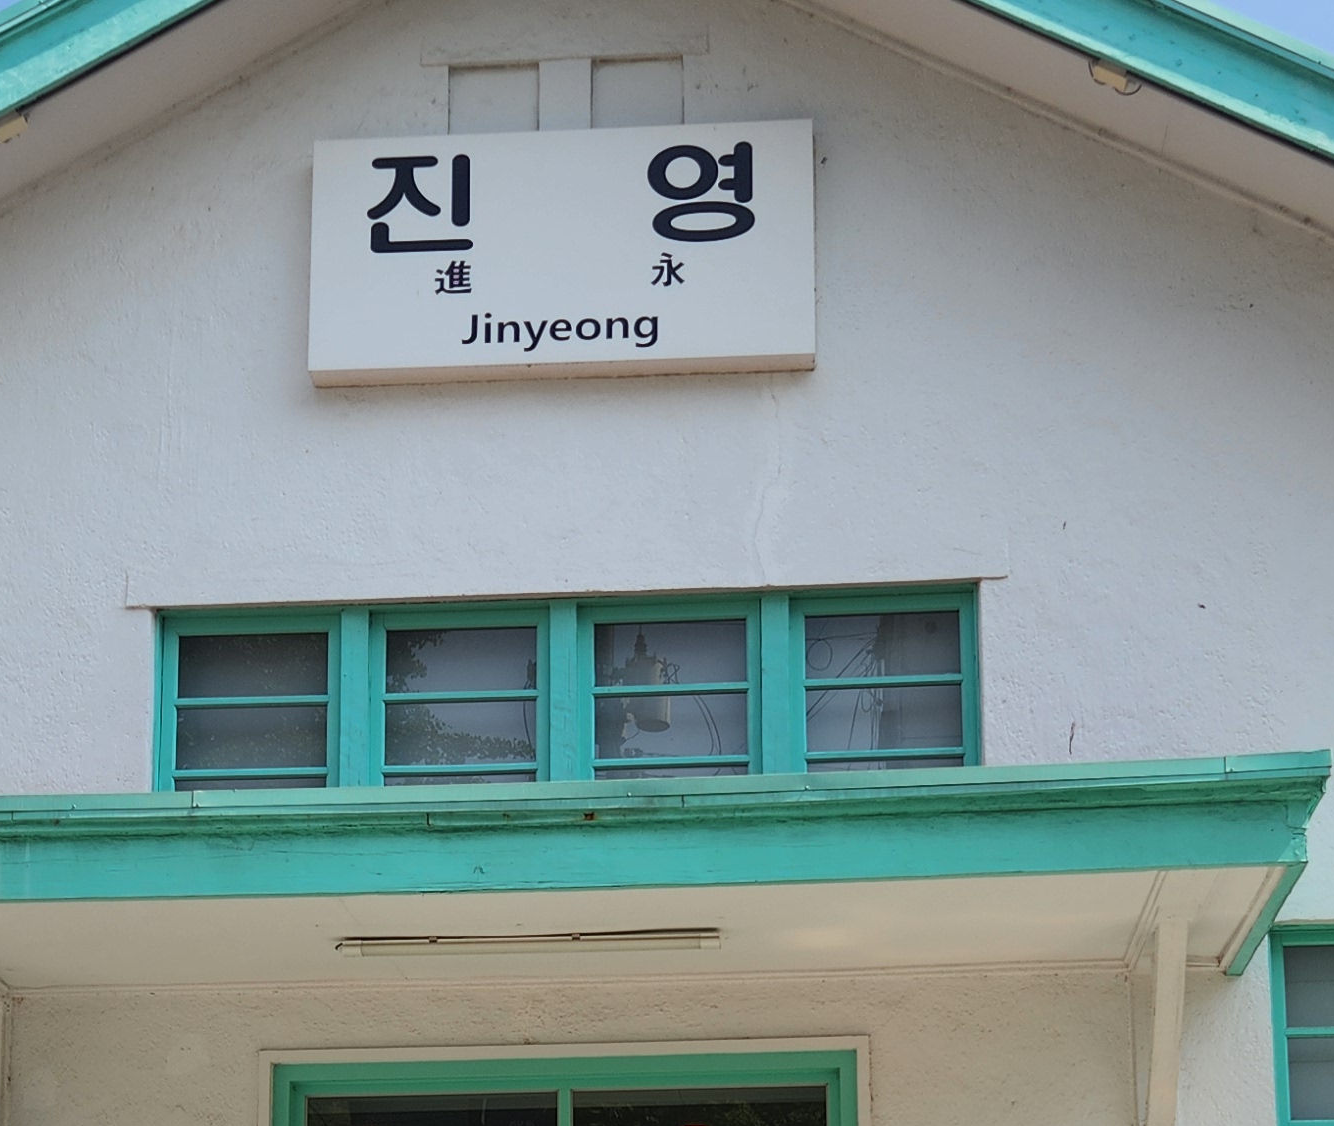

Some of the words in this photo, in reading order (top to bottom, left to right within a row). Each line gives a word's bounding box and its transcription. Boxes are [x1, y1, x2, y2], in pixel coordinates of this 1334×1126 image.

[367, 154, 473, 253] 진
[647, 141, 755, 242] 영
[651, 252, 685, 286] 永
[462, 313, 658, 351] Jinyeong
